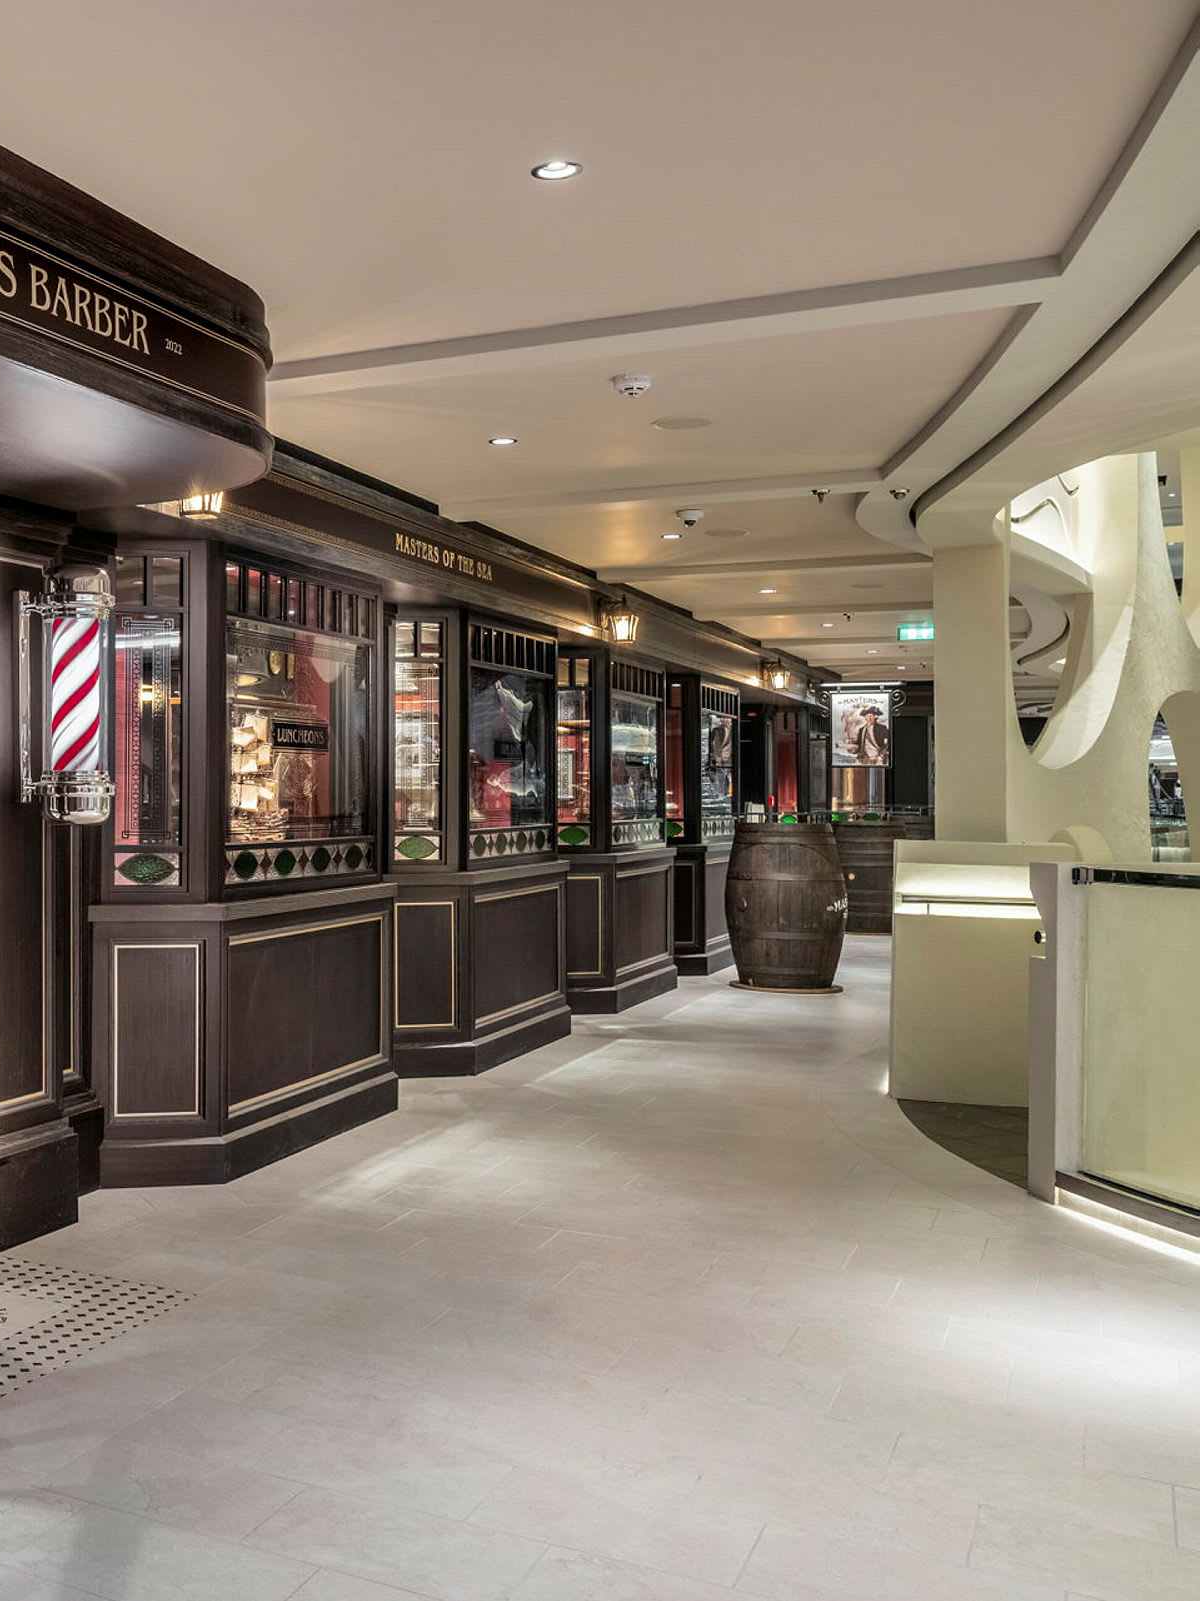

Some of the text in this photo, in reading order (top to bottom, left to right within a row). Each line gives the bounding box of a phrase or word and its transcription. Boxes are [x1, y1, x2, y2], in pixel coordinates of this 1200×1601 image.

[28, 262, 151, 356] BARBER
[164, 337, 184, 356] 2022
[395, 533, 494, 581] MASTERS OF THE SEA
[277, 727, 326, 746] LUNCHEONS
